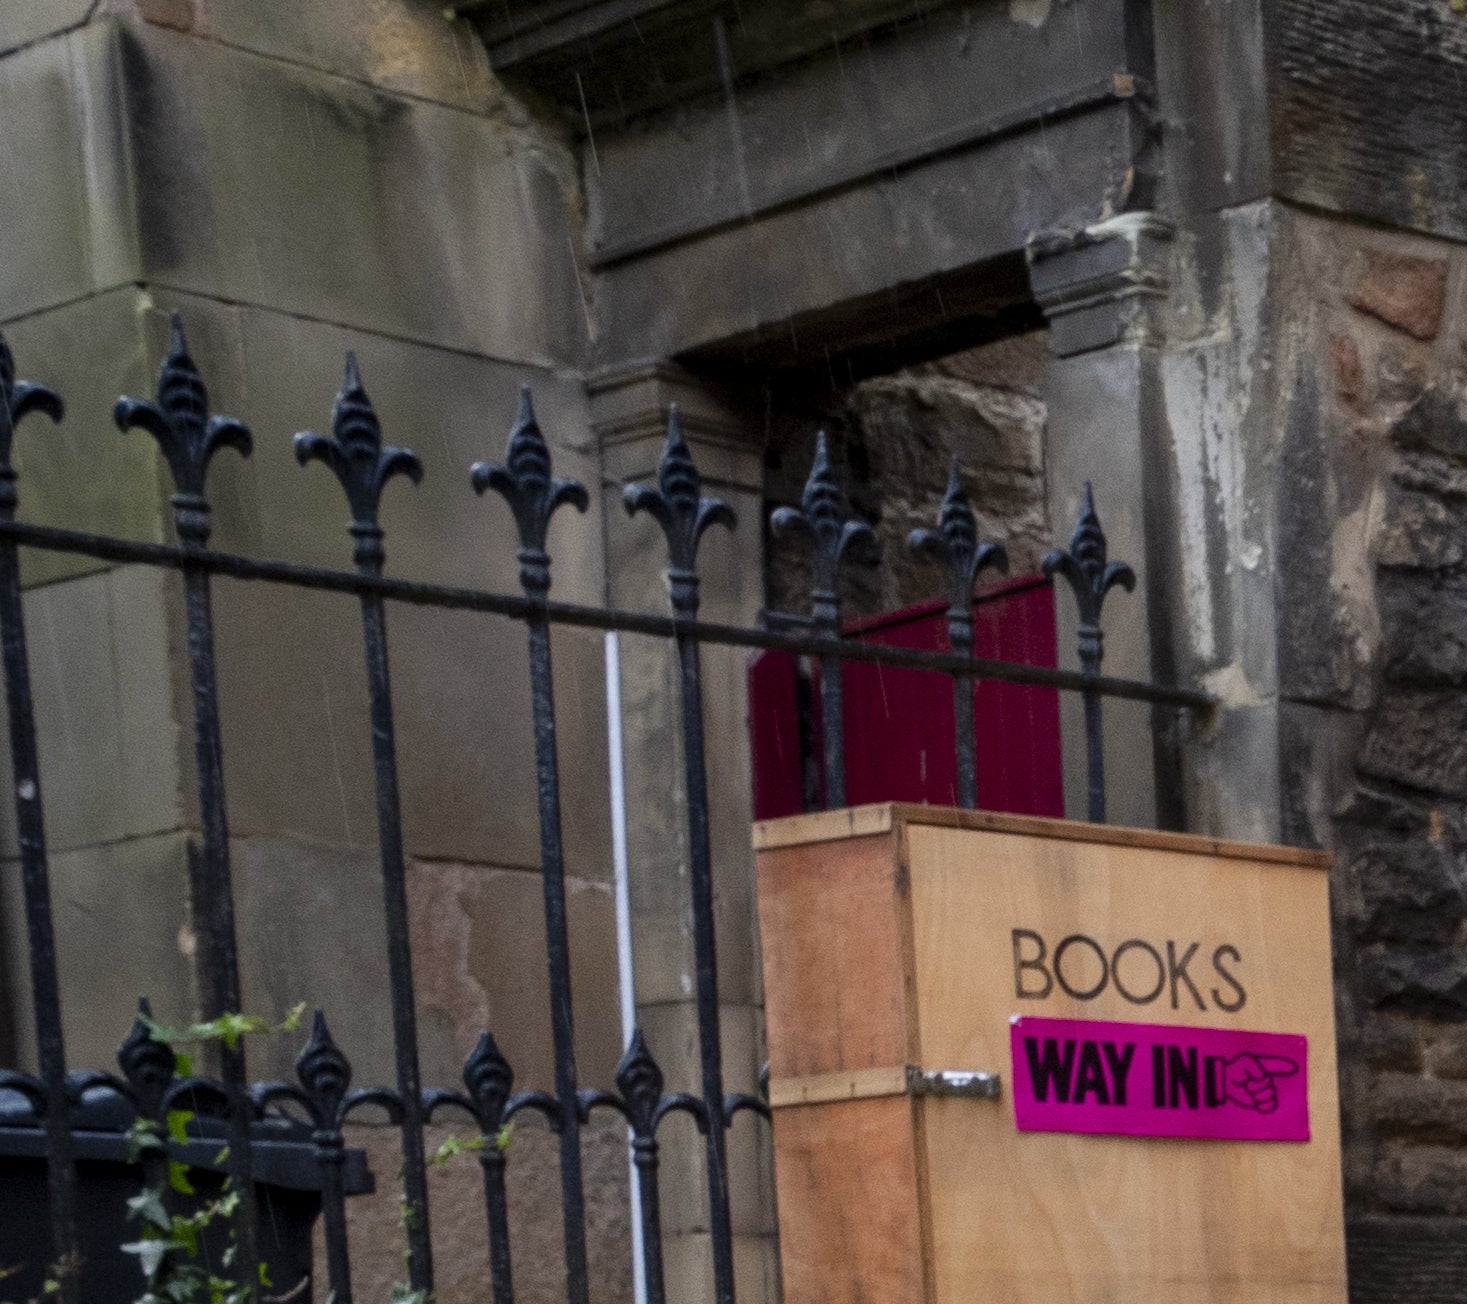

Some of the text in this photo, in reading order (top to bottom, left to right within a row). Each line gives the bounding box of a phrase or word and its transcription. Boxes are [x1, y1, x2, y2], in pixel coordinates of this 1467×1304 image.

[1011, 928, 1248, 1013] BOOKS
[1023, 1036, 1199, 1109] WAY IN
